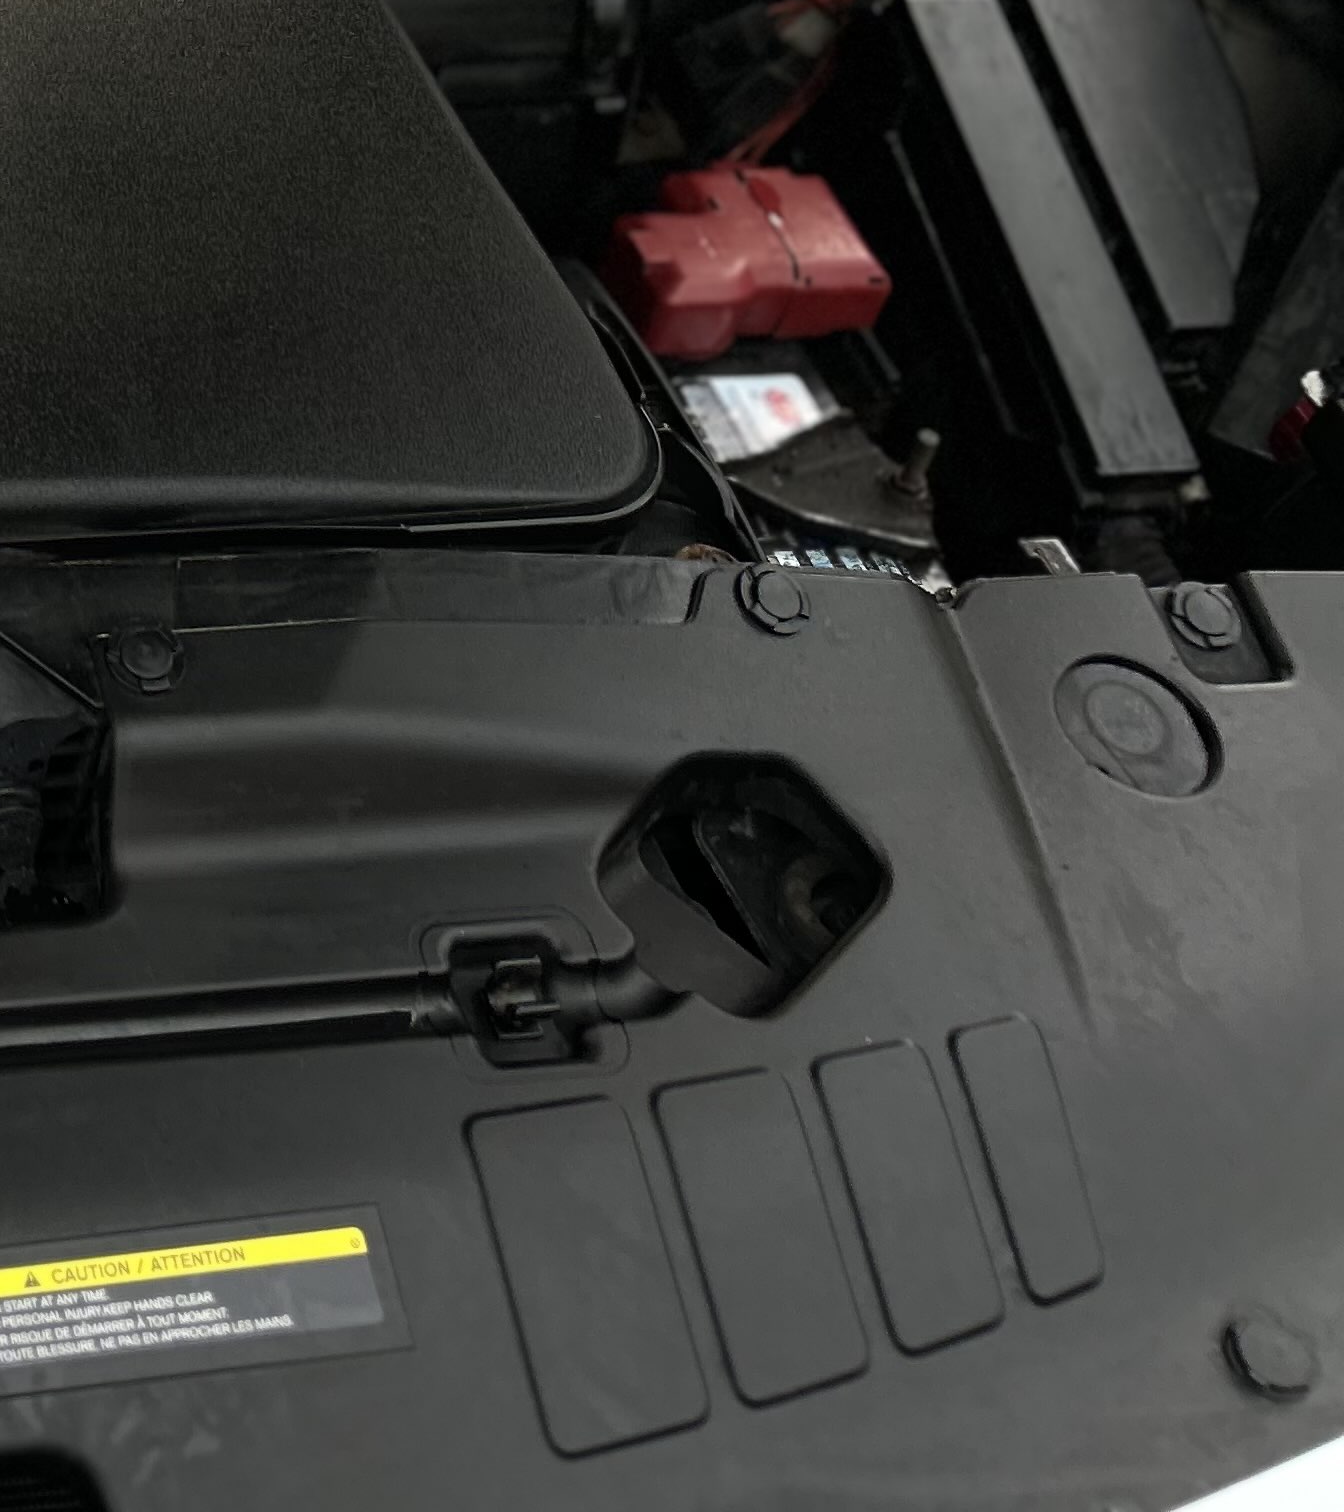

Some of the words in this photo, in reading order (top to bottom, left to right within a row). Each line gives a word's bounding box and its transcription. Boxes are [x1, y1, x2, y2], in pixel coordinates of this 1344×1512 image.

[51, 1260, 131, 1286] CAUTION
[150, 1246, 246, 1273] ATTENTION
[2, 1310, 64, 1328] PERSONAL
[133, 1295, 173, 1311] HANDS
[4, 1297, 38, 1313] START
[40, 1295, 54, 1307] AT
[56, 1291, 79, 1306] ANY
[10, 1328, 53, 1345] RISQUE
[55, 1326, 70, 1339] DE
[73, 1317, 134, 1337] DÉMARRER
[136, 1313, 146, 1329] À
[147, 1312, 177, 1326] TOUT
[100, 1336, 117, 1350] NE
[118, 1333, 141, 1348] PAS
[143, 1331, 159, 1344] EN
[161, 1322, 231, 1343] APPROCHER
[232, 1319, 254, 1333] LES
